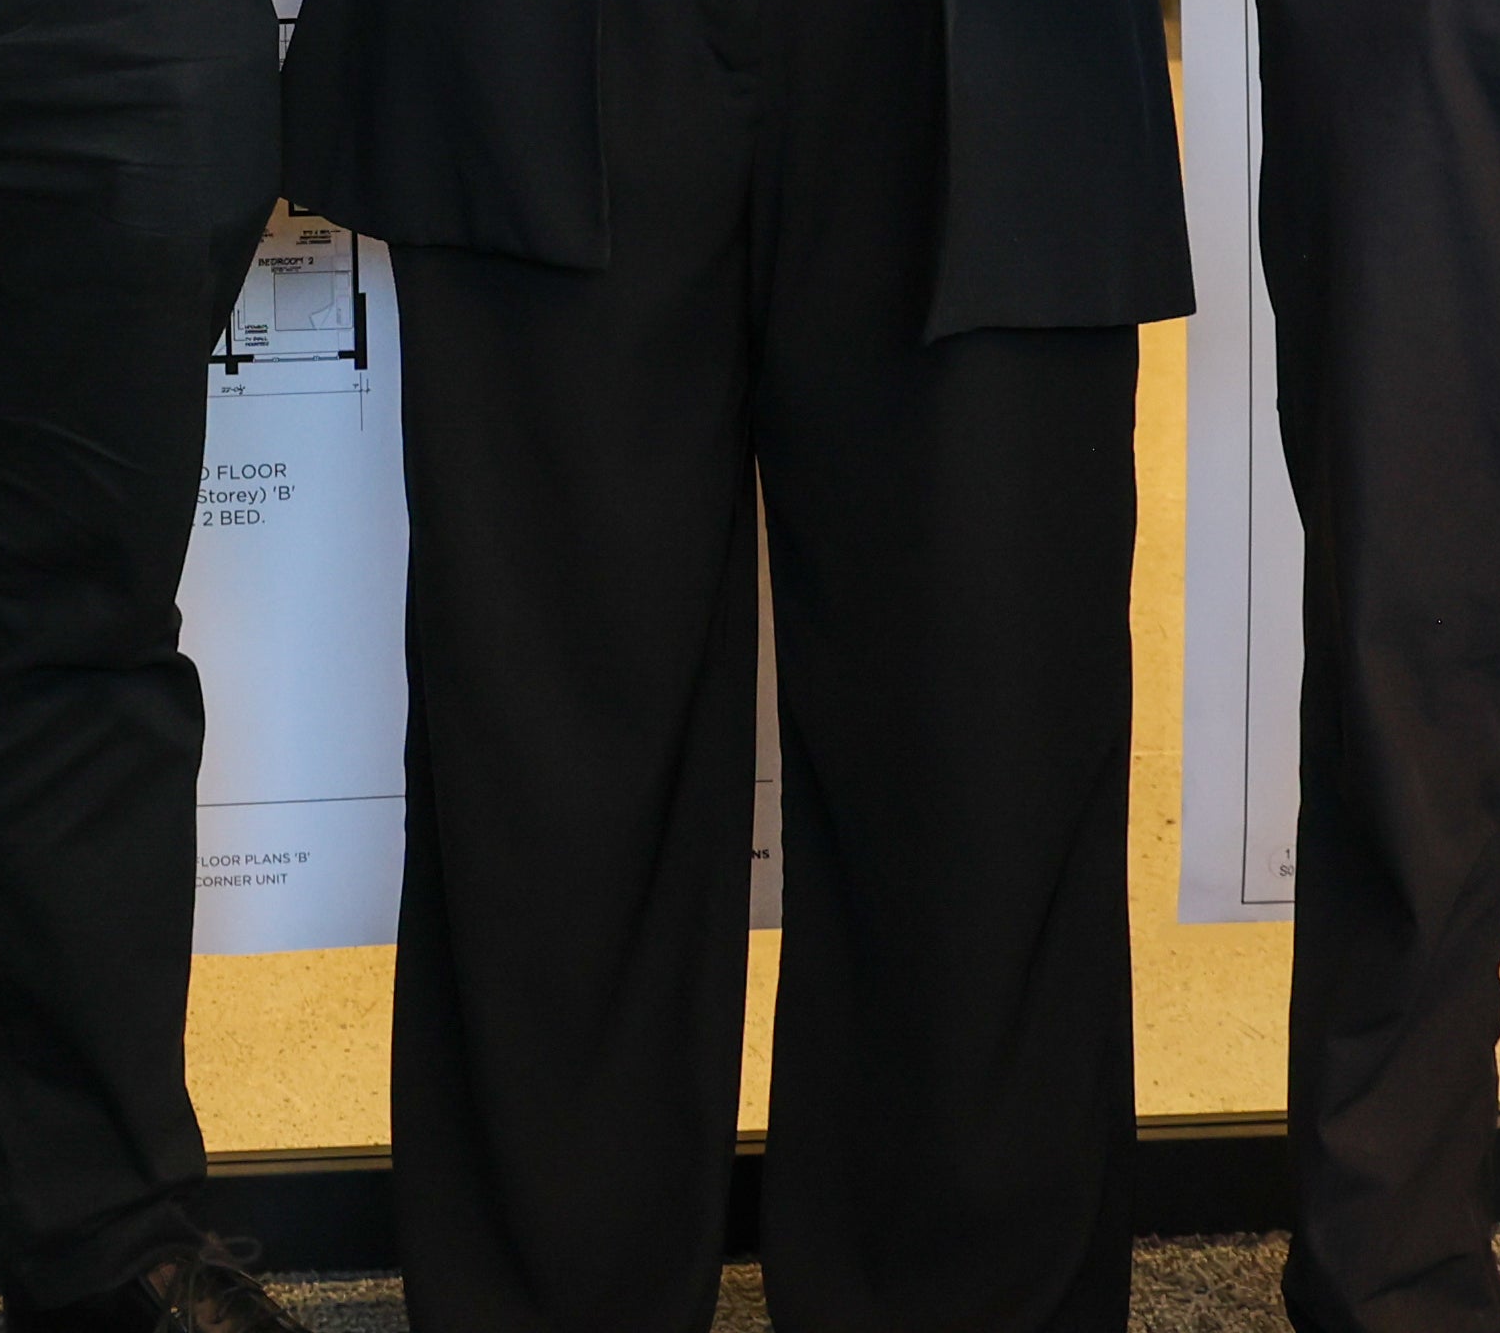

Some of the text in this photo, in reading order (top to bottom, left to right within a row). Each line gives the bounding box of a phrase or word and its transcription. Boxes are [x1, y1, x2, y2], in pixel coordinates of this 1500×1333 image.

[217, 463, 288, 481] FLOOR
[273, 485, 295, 502] 'B'
[203, 510, 266, 526] 2 BED.
[245, 852, 291, 867] PLANS
